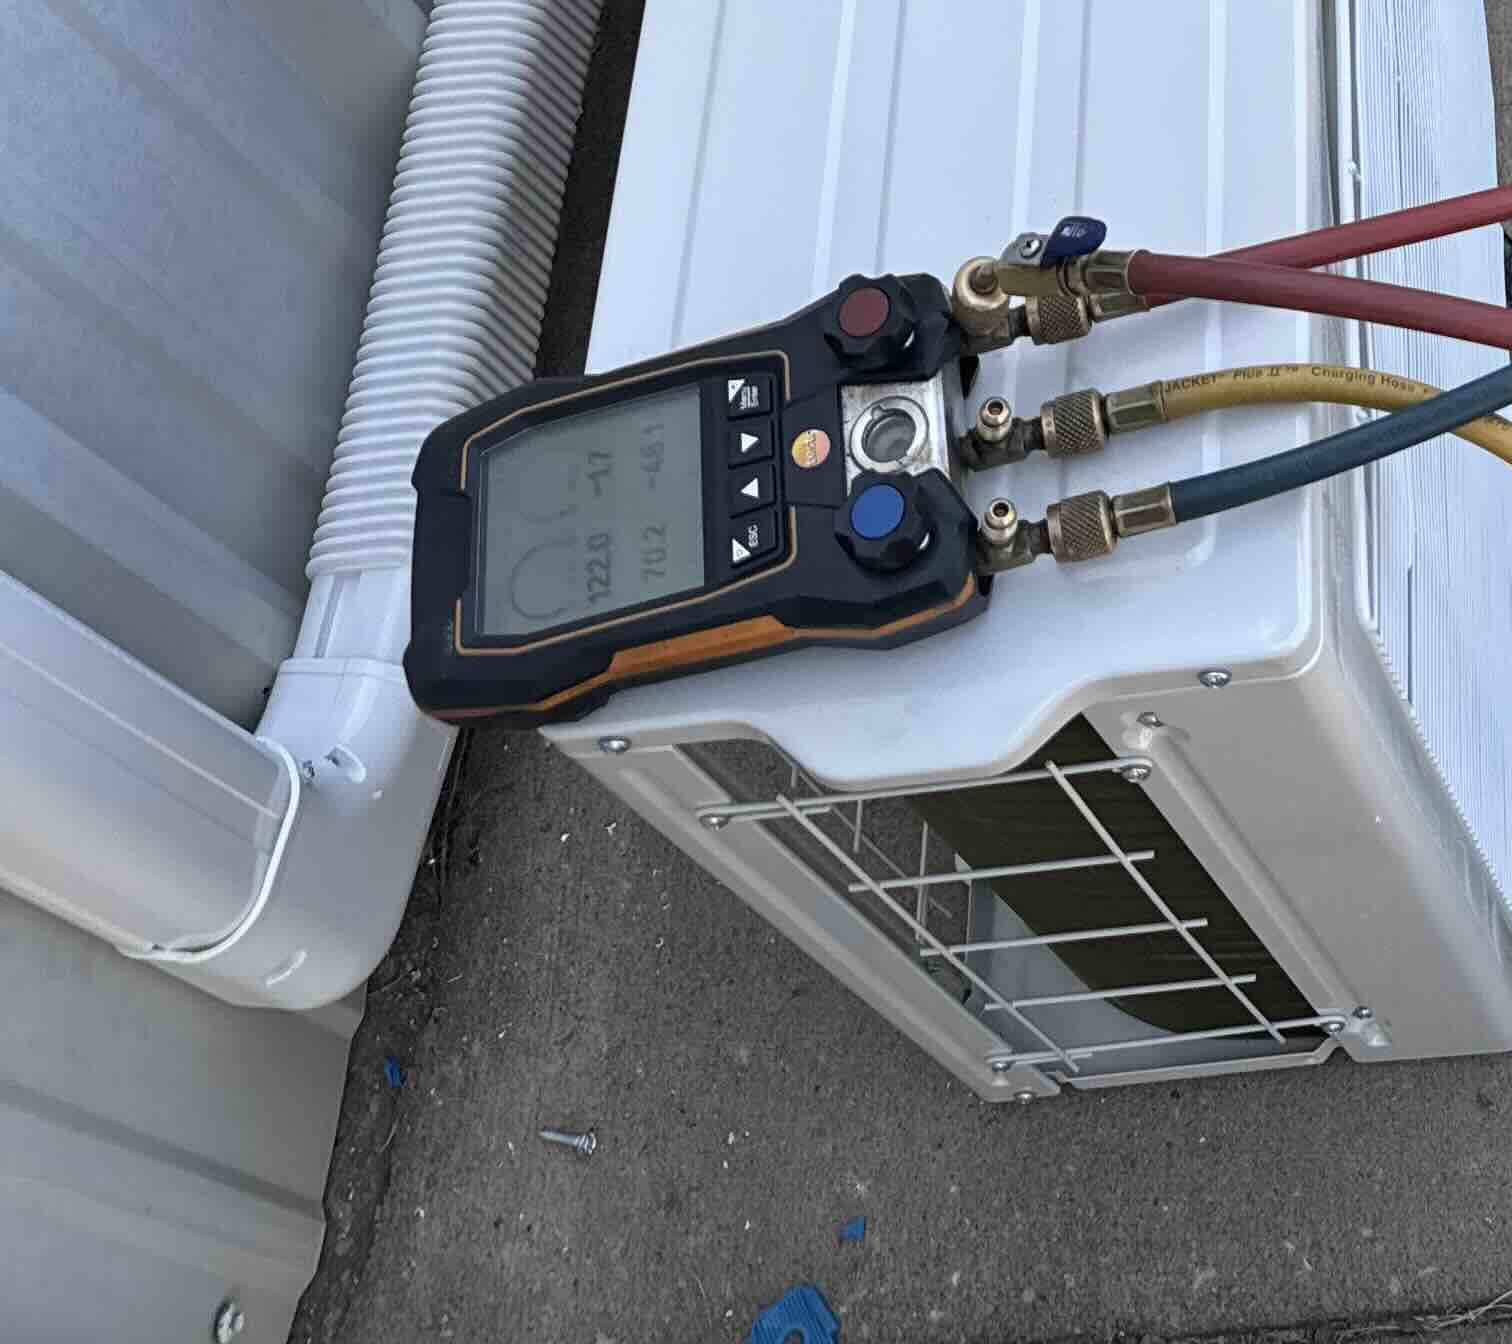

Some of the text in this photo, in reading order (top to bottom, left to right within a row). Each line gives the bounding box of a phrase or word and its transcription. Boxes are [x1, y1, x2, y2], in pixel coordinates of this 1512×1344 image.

[1164, 374, 1218, 394] JACKET
[1232, 367, 1264, 381] Plus
[1310, 366, 1376, 385] Charging
[1380, 373, 1416, 393] Hose
